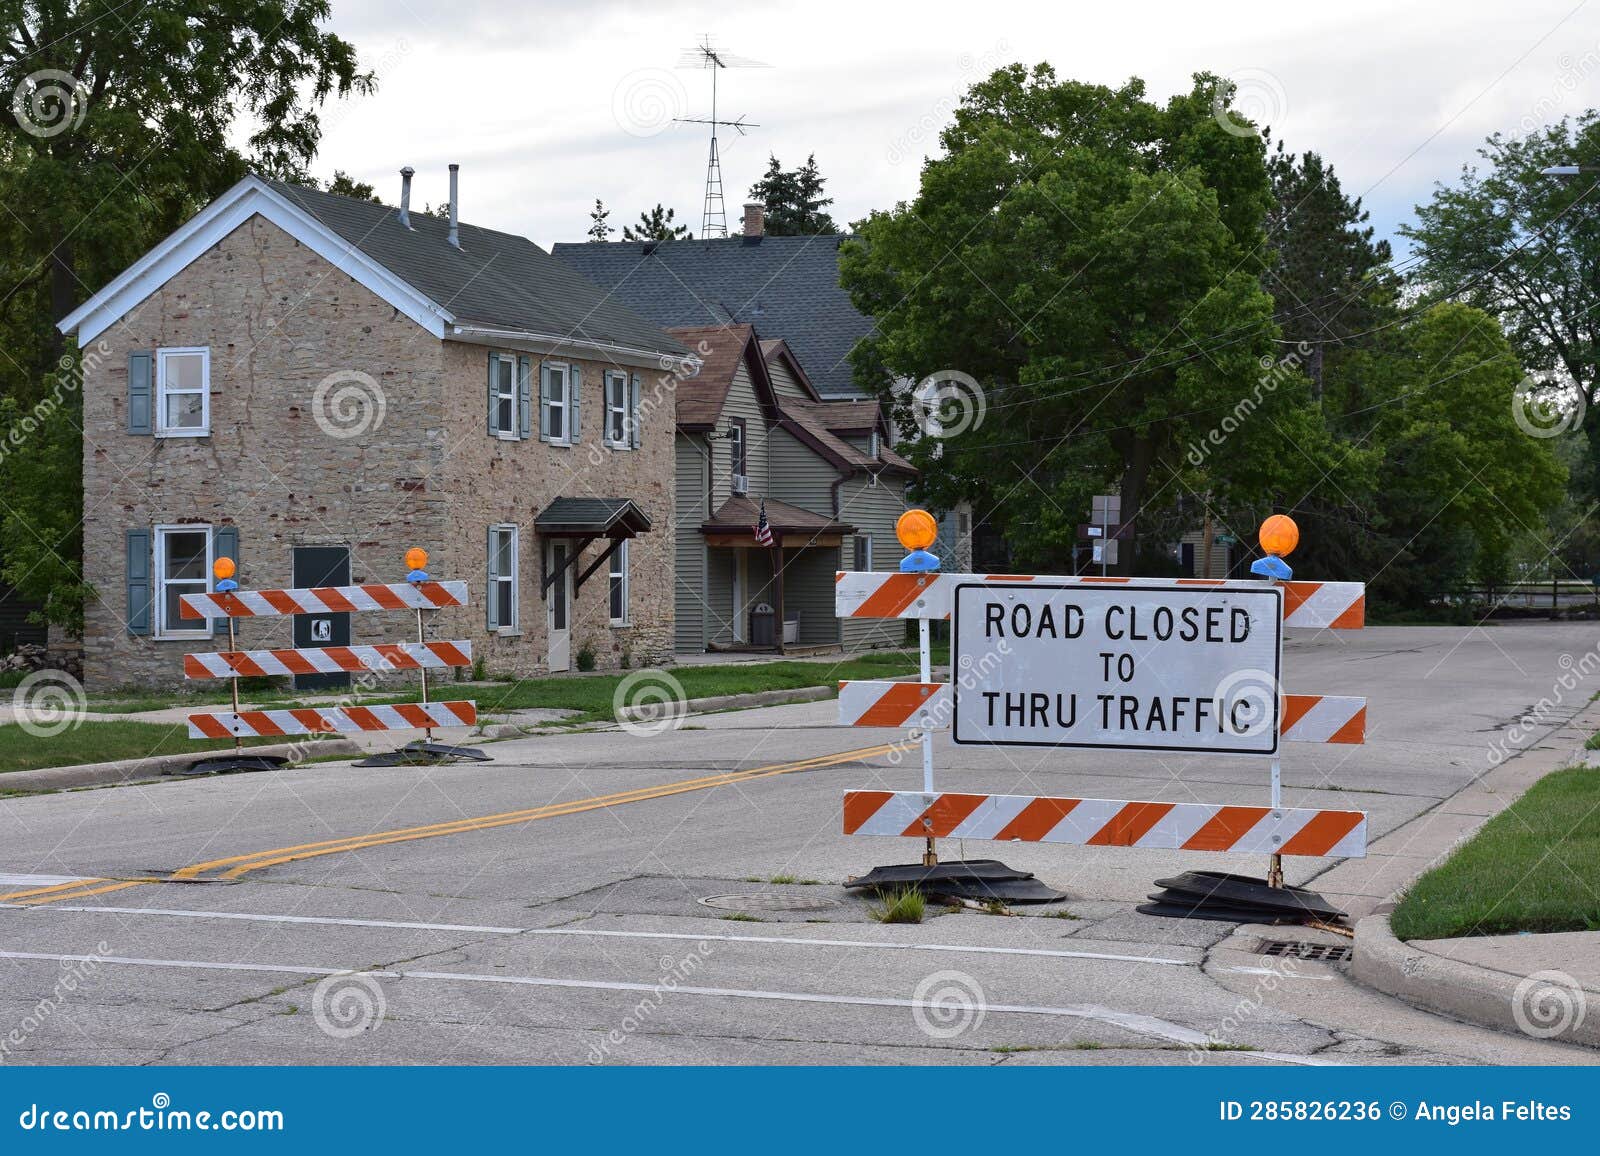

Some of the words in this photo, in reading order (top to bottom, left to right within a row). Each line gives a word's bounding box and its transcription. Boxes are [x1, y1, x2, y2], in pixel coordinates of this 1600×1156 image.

[985, 602, 1085, 639] ROAD
[1105, 605, 1250, 643] CLOSED
[1099, 652, 1135, 683] TO
[982, 691, 1077, 729] THRU
[1097, 694, 1251, 734] TRAFFIC
